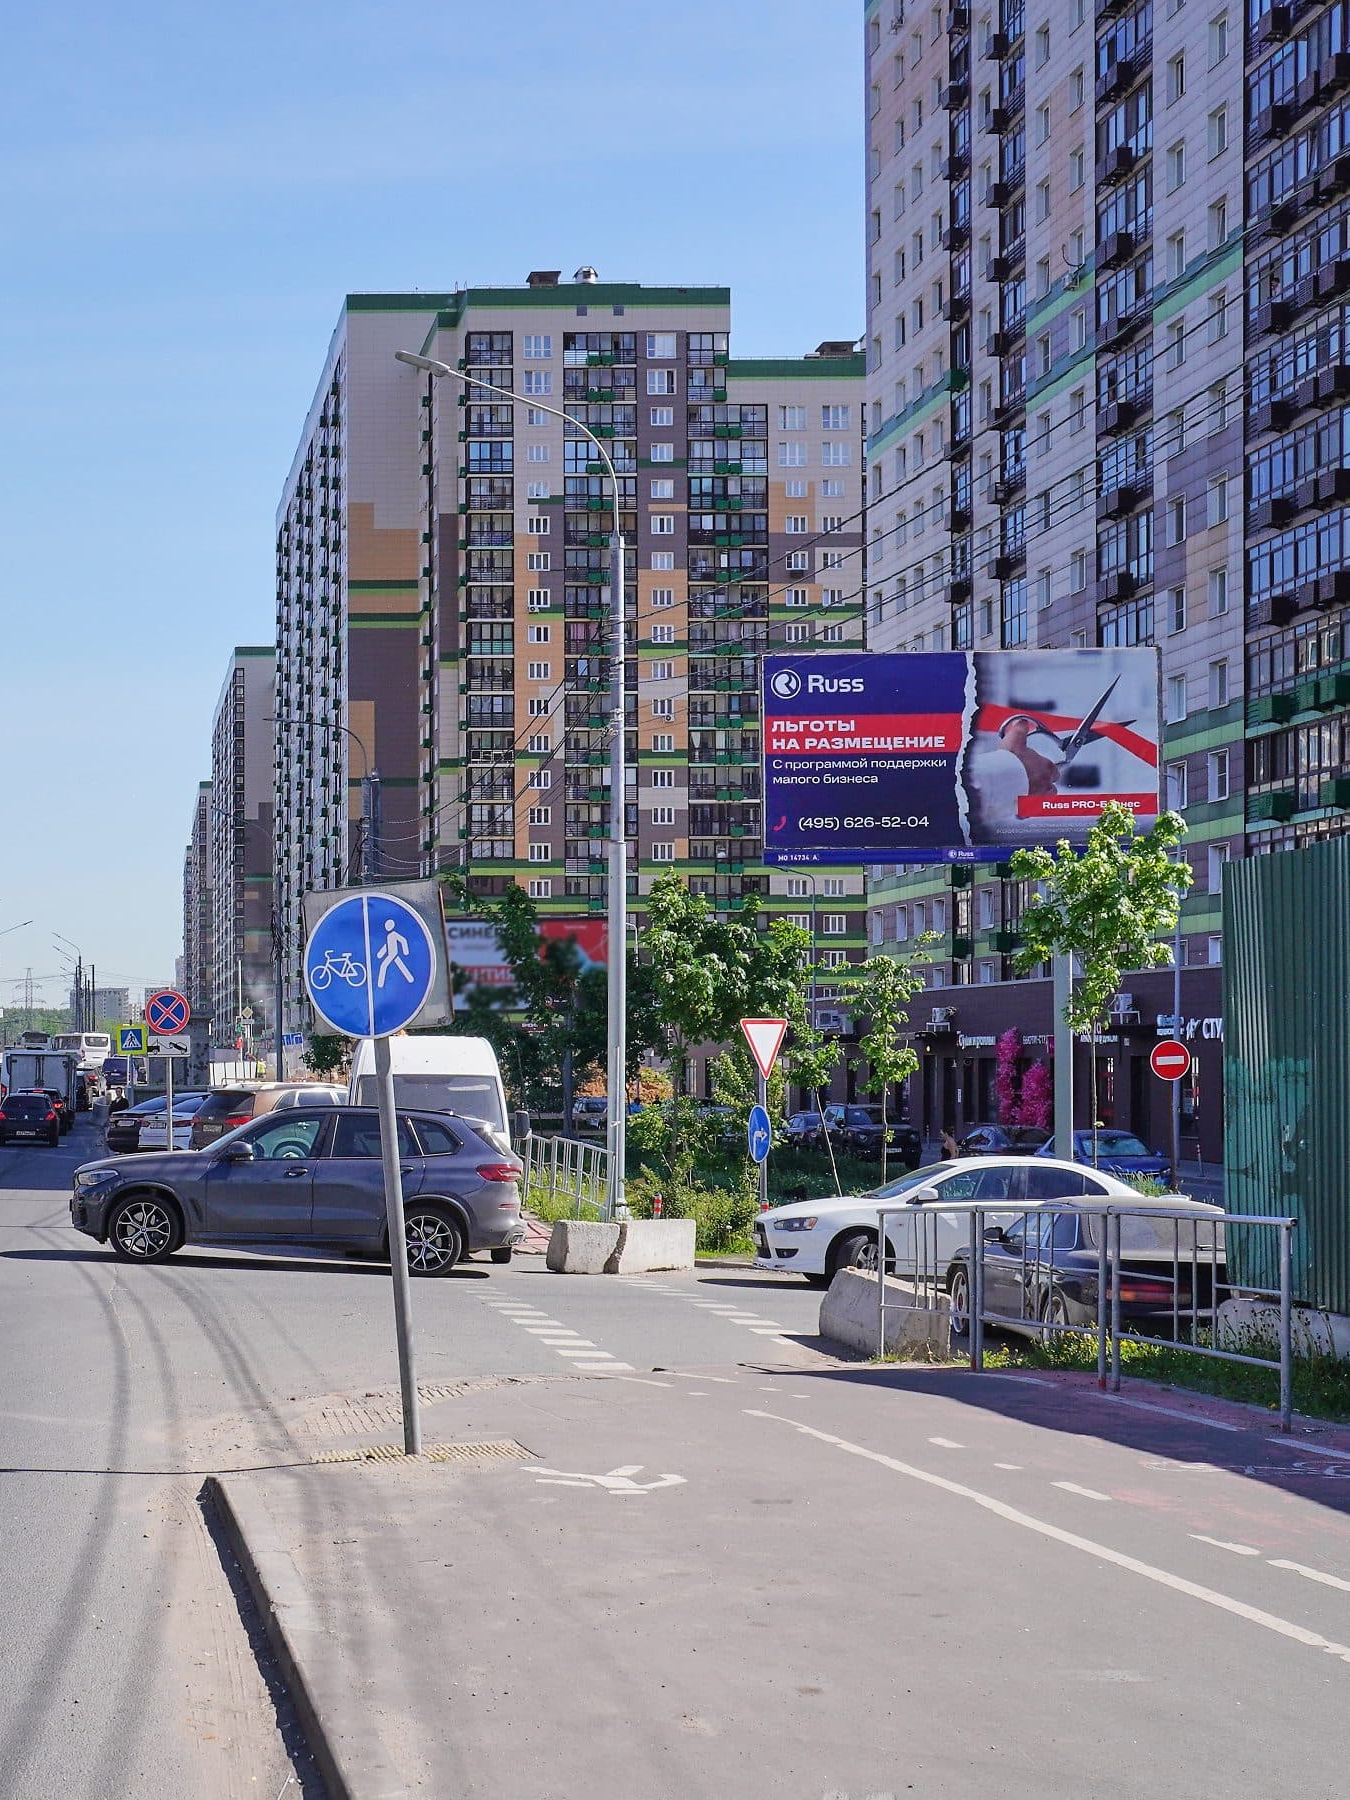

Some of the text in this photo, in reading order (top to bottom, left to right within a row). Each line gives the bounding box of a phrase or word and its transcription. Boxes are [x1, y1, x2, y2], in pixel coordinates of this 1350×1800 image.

[808, 674, 864, 693] Russ
[771, 720, 855, 733] ЛЬГОТЫ
[772, 736, 946, 751] НА РАЗМЕЩЕНИЕ
[772, 757, 947, 773] С программой поддержки
[772, 773, 879, 786] малого бизнеса
[1042, 801, 1070, 810] Russ
[798, 816, 930, 831] (495) 626-52-04
